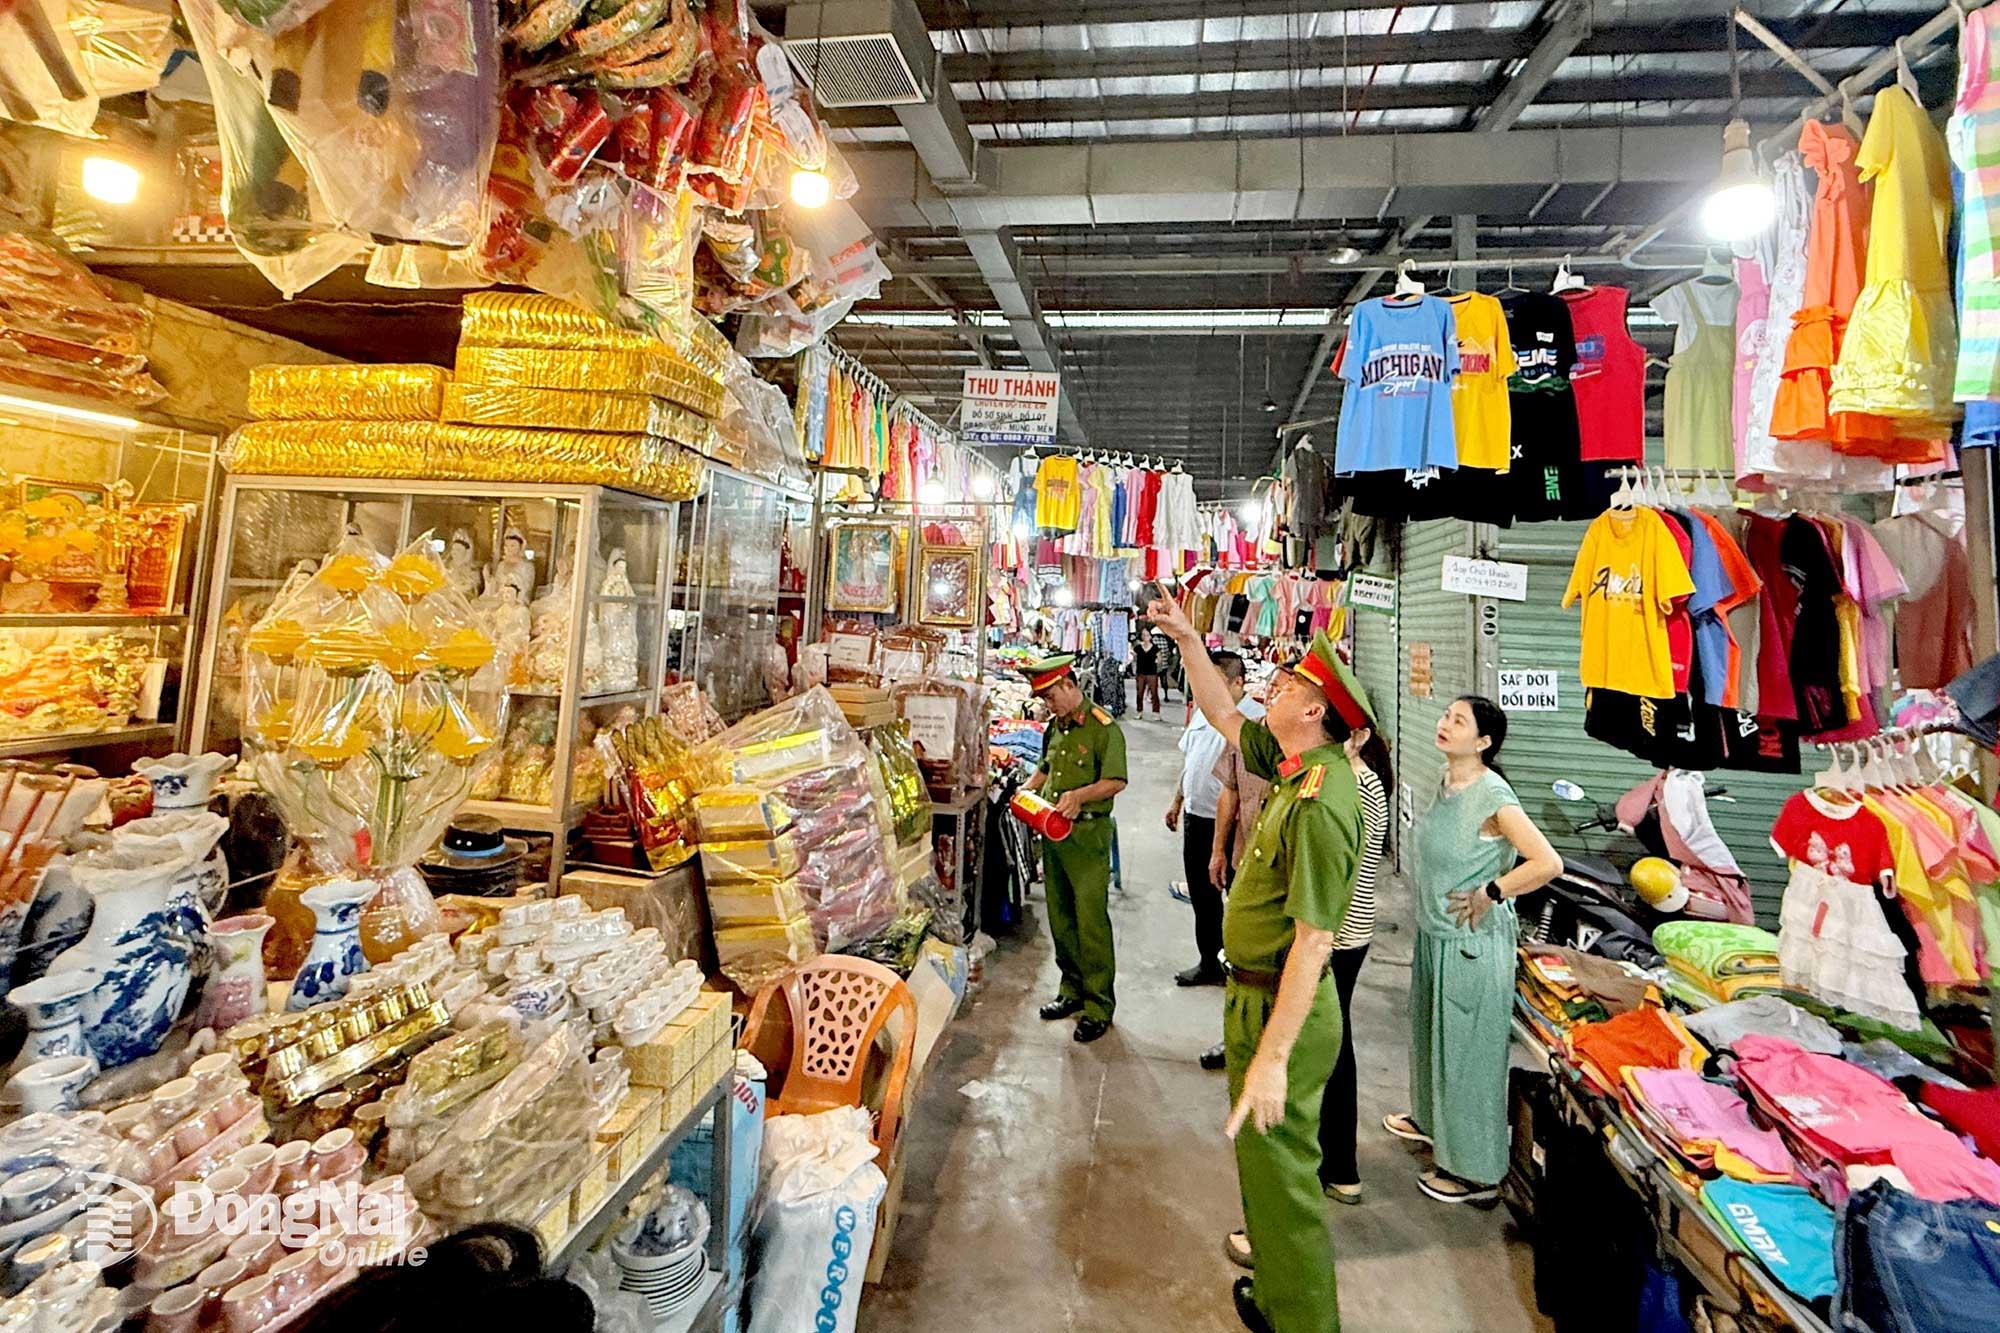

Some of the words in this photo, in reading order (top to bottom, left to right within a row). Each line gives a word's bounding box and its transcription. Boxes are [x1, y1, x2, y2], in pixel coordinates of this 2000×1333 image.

[1360, 353, 1443, 388] MICHIGAN
[968, 377, 999, 395] THU
[1380, 370, 1424, 397] Sport
[1527, 692, 1556, 708] DIỆN
